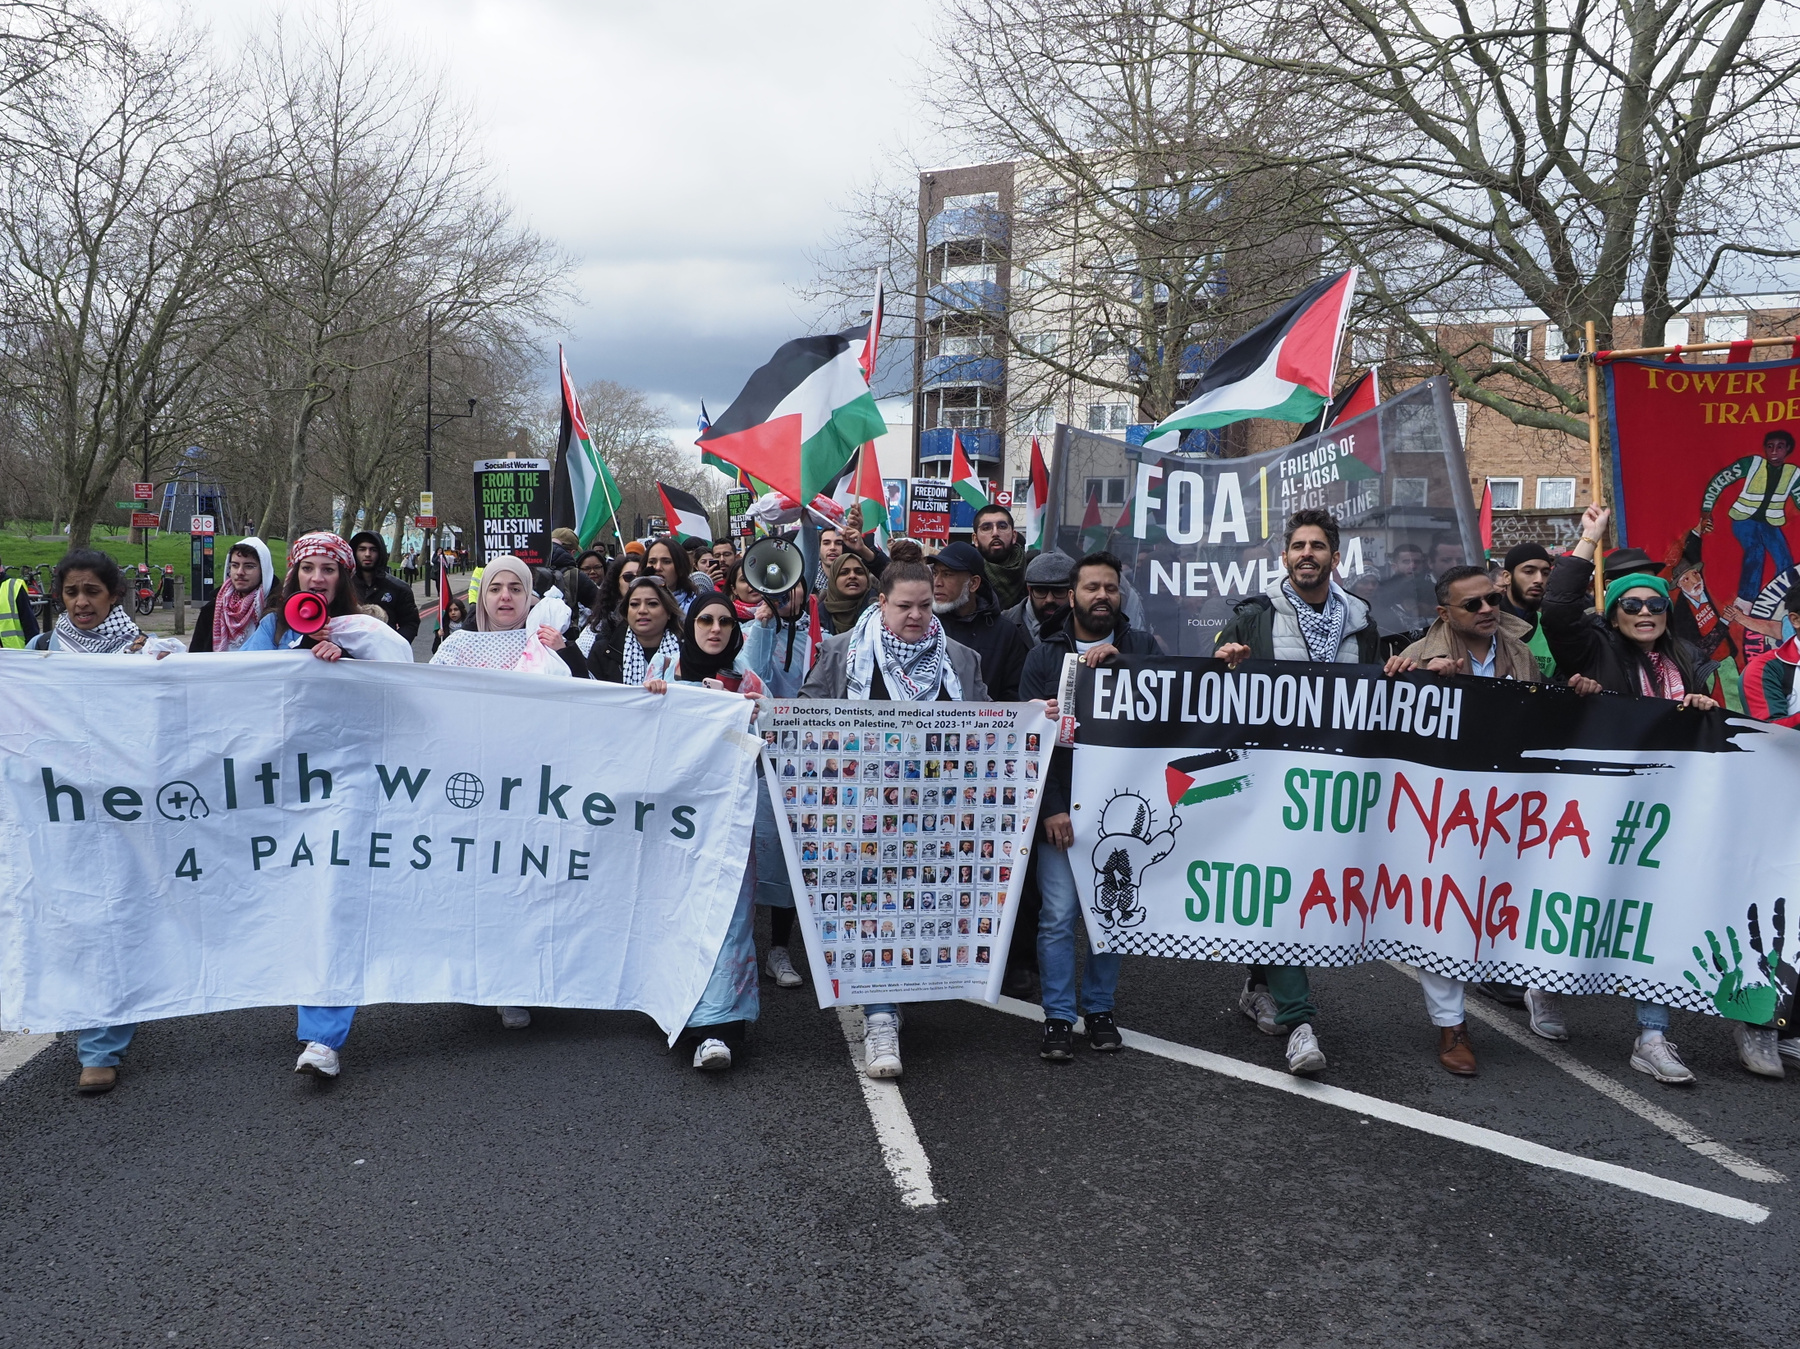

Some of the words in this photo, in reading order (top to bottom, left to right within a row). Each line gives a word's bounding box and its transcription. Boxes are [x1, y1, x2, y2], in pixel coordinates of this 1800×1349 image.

[1640, 367, 1767, 395] TOWER
[1280, 443, 1337, 479] FRIENDS
[1339, 434, 1356, 457] OF
[484, 462, 513, 470] Socialist
[514, 461, 539, 469] Worker
[482, 473, 514, 487] FROM
[518, 472, 540, 487] THE
[1281, 463, 1340, 498] AL-AQSA
[1703, 462, 1743, 511] DOCKERS
[482, 489, 515, 503] RIVER
[519, 488, 534, 502] TO
[915, 486, 948, 498] FREEDOM
[912, 500, 949, 512] PALESTINE
[1133, 462, 1250, 544] FOA
[1281, 488, 1326, 516] PEACE
[1321, 490, 1374, 521] ESTINE
[483, 504, 504, 518] THE
[507, 504, 529, 518] SEA
[483, 519, 543, 534] PALESTINE
[917, 514, 941, 524] الحرية
[484, 535, 511, 549] WILL
[514, 534, 529, 549] BE
[1150, 536, 1365, 597] NEWHM
[1751, 571, 1792, 618] UNITY
[1187, 619, 1223, 628] FOLLOW
[1068, 667, 1076, 680] PART
[1065, 686, 1073, 701] WILL
[1063, 701, 1072, 715] GAZA
[1092, 668, 1177, 721] EAST
[1182, 670, 1326, 730] LONDON
[1331, 678, 1464, 741] MARCH
[773, 706, 790, 715] 127
[792, 706, 832, 716] Doctors,
[834, 707, 875, 717] Dentists,
[878, 708, 896, 717] and
[898, 708, 934, 718] medical
[936, 709, 976, 718] students
[978, 709, 1004, 718] killed
[1006, 709, 1018, 720] by
[773, 718, 800, 727] Israeli
[802, 719, 837, 728] attacks
[838, 720, 851, 728] on
[854, 720, 898, 729] Palestine,
[901, 720, 914, 729] 7th
[916, 720, 932, 729] Oct
[974, 721, 990, 729] Jan
[993, 721, 1015, 729] 2024
[1282, 767, 1382, 834] STOP
[1387, 771, 1591, 864] NAKBA
[1608, 800, 1671, 869] #2
[174, 847, 204, 882] 4
[252, 829, 592, 881] PALESTINE
[1185, 859, 1292, 928] STOP
[1299, 863, 1521, 963] ARMING
[1525, 888, 1656, 965] ISRAEL
